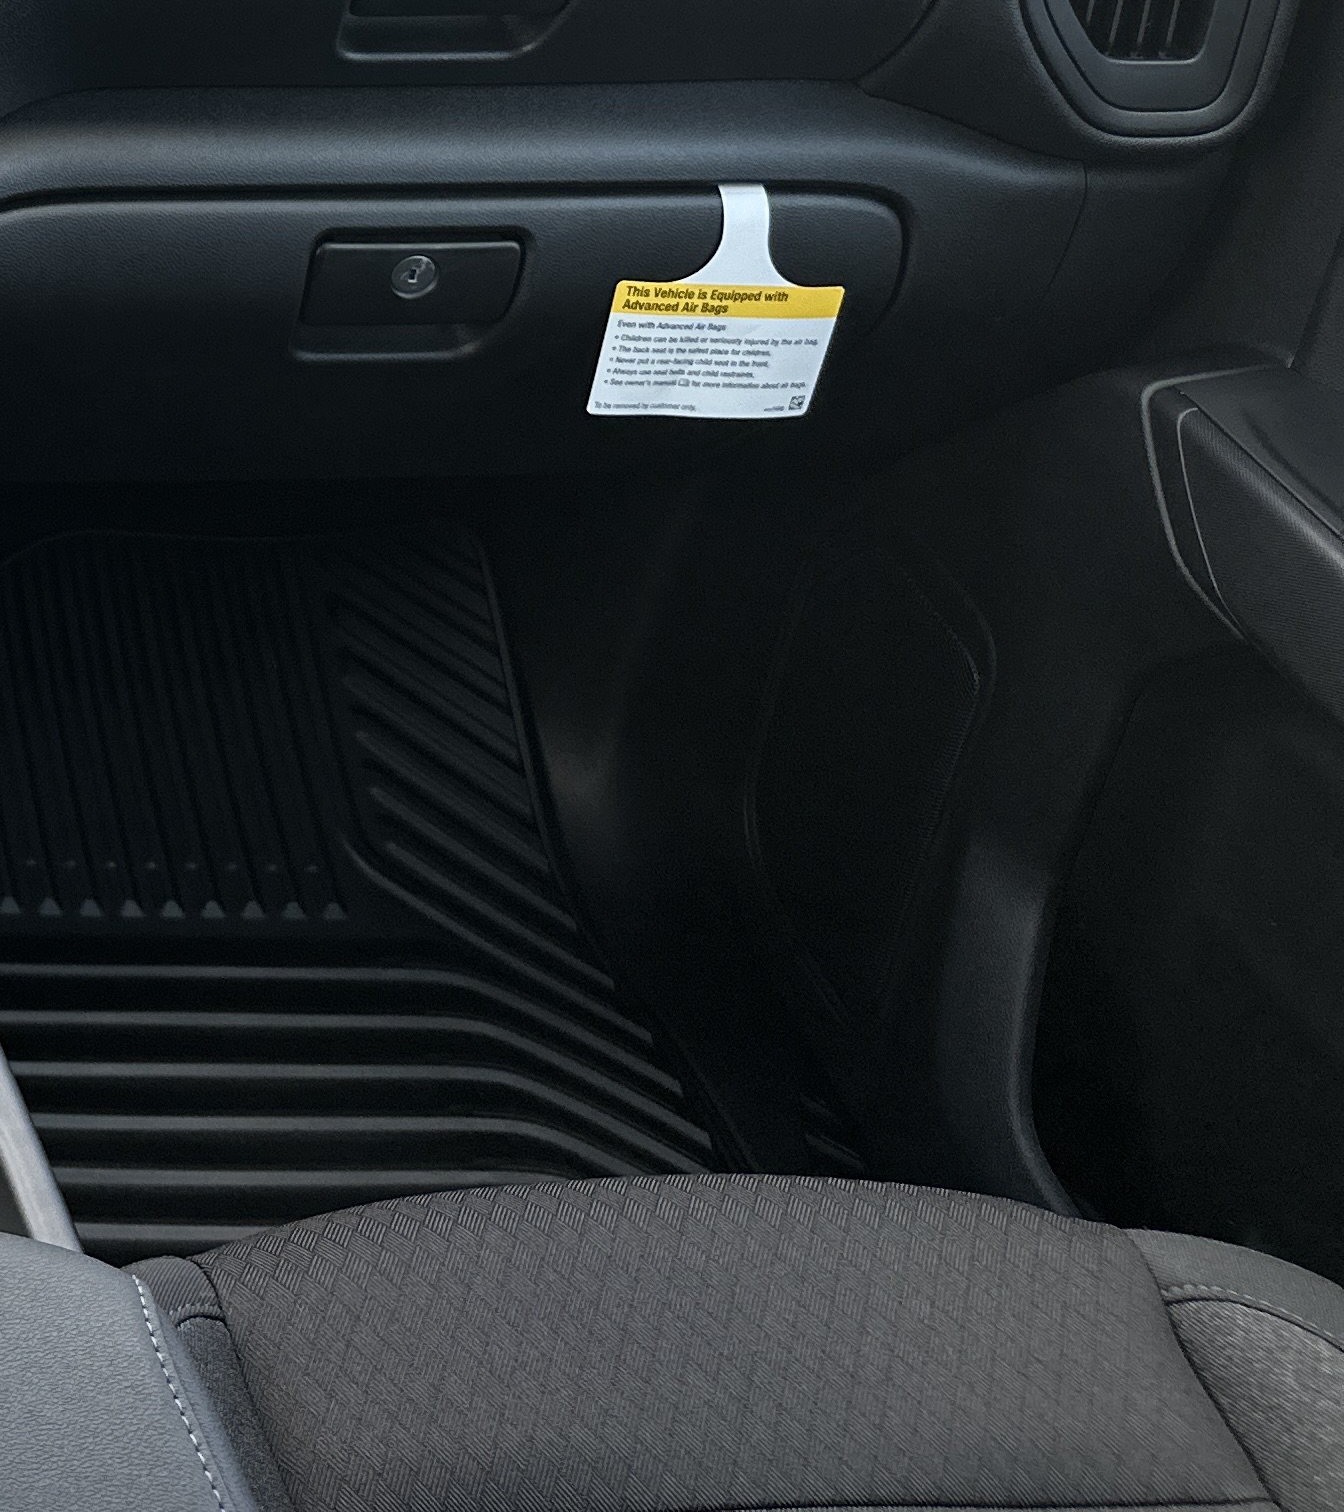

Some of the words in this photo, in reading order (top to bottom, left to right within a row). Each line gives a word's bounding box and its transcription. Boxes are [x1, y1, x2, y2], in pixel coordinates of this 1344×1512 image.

[626, 286, 650, 298] This
[654, 287, 695, 299] Vehicle
[697, 289, 708, 300] is
[710, 289, 762, 303] Equipped
[764, 290, 789, 302] with
[622, 299, 679, 312] Advanced
[681, 301, 699, 313] Air
[700, 302, 729, 315] Bags
